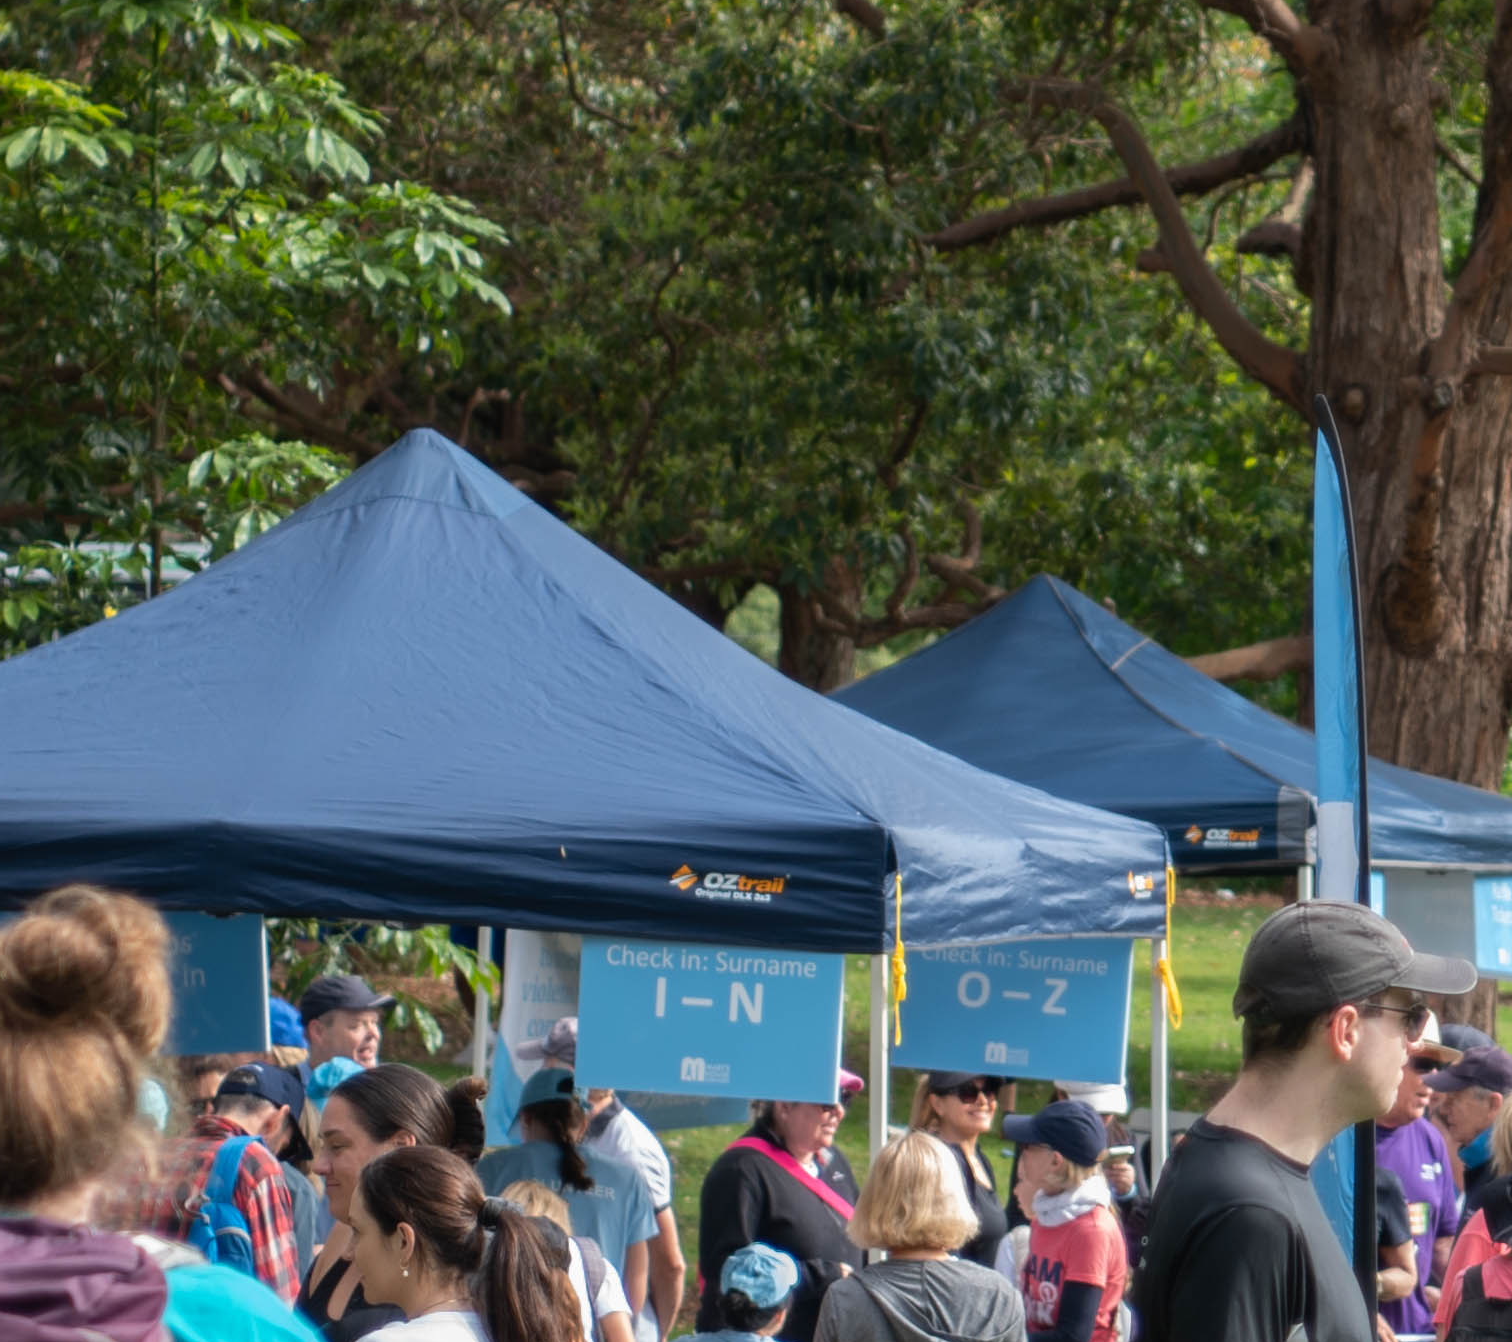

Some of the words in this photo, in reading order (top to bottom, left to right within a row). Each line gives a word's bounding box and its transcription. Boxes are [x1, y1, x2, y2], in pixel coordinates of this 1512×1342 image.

[695, 888, 732, 899] Original
[606, 944, 673, 969] Check
[681, 949, 708, 971] in:
[715, 952, 817, 978] Surname
[987, 948, 1012, 968] in:
[1018, 950, 1109, 975] Surname
[655, 976, 667, 1017] I
[729, 981, 764, 1023] N
[957, 970, 991, 1009] O
[1041, 978, 1069, 1016] Z
